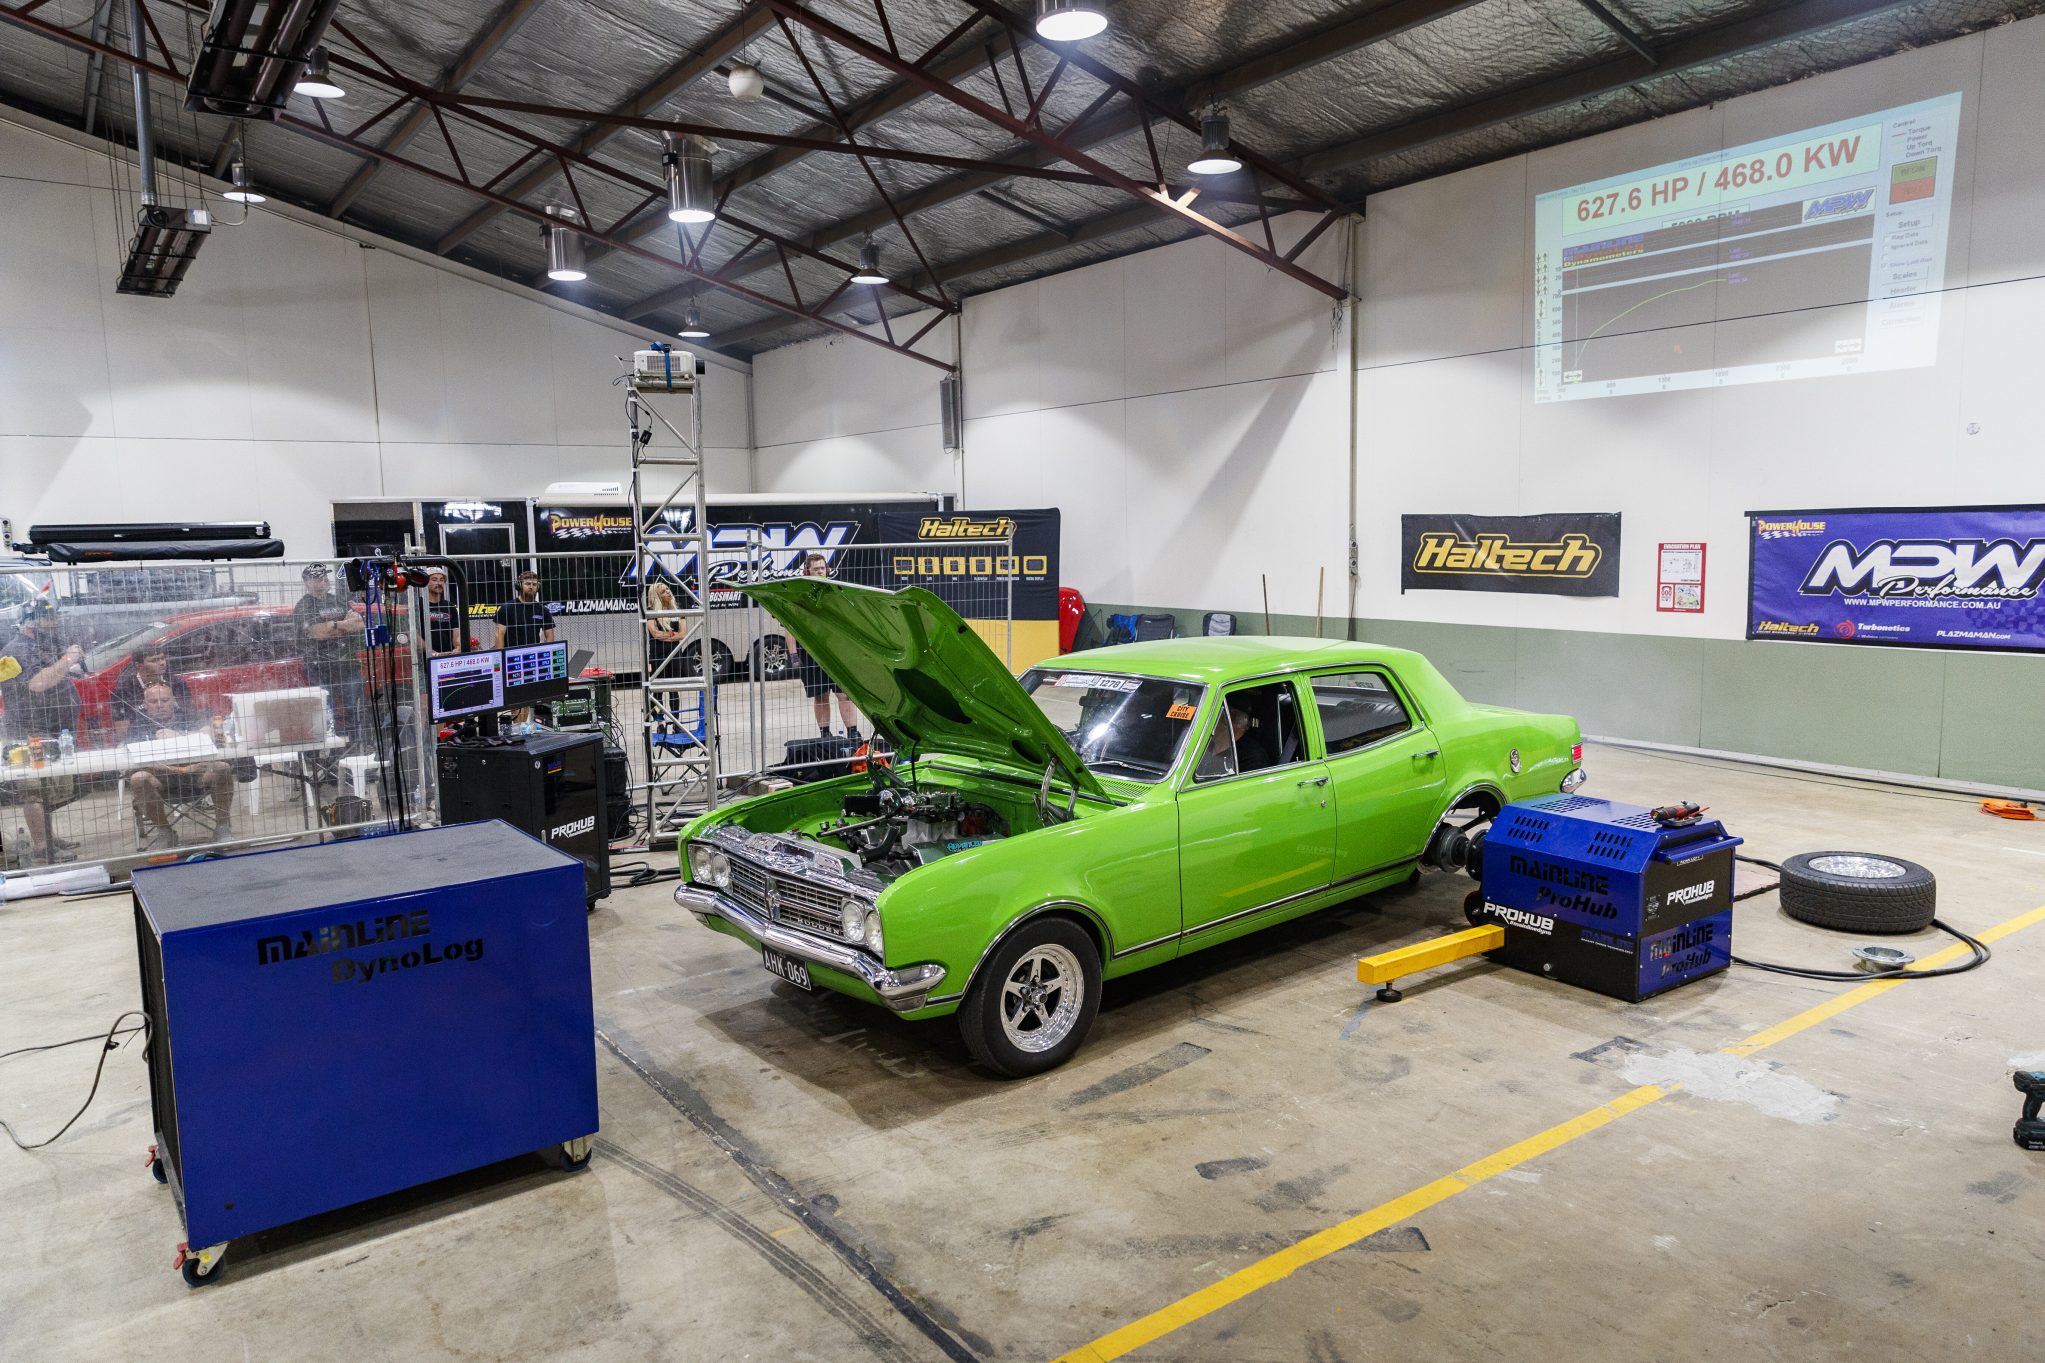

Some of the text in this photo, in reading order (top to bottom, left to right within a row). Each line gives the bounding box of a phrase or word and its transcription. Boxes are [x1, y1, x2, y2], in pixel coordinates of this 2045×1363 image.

[1577, 188, 1642, 222] 627.6
[1651, 176, 1689, 206] HP
[1696, 171, 1707, 197] /
[1714, 152, 1793, 191] 468.0
[1803, 136, 1861, 173] KW
[1804, 188, 1875, 219] MPW
[920, 518, 1014, 538] Haltech
[1418, 538, 1596, 572] Haltech
[1809, 544, 2045, 588] MPW
[1877, 574, 2036, 601] Performance
[1844, 597, 2001, 610] WWW.MPWPERFORMANCE.COM.AU
[1757, 621, 1820, 633] Haltech
[1857, 622, 1910, 632] Turbonetics
[454, 660, 463, 668] HP
[551, 815, 595, 839] PROHUB
[1536, 885, 1618, 919] ProHub
[1666, 879, 1715, 906] PROHUB
[797, 917, 840, 934] HOLDEN
[1483, 901, 1554, 931] PROHUB
[332, 937, 484, 985] DynoLog
[1662, 948, 1712, 977] ProHub
